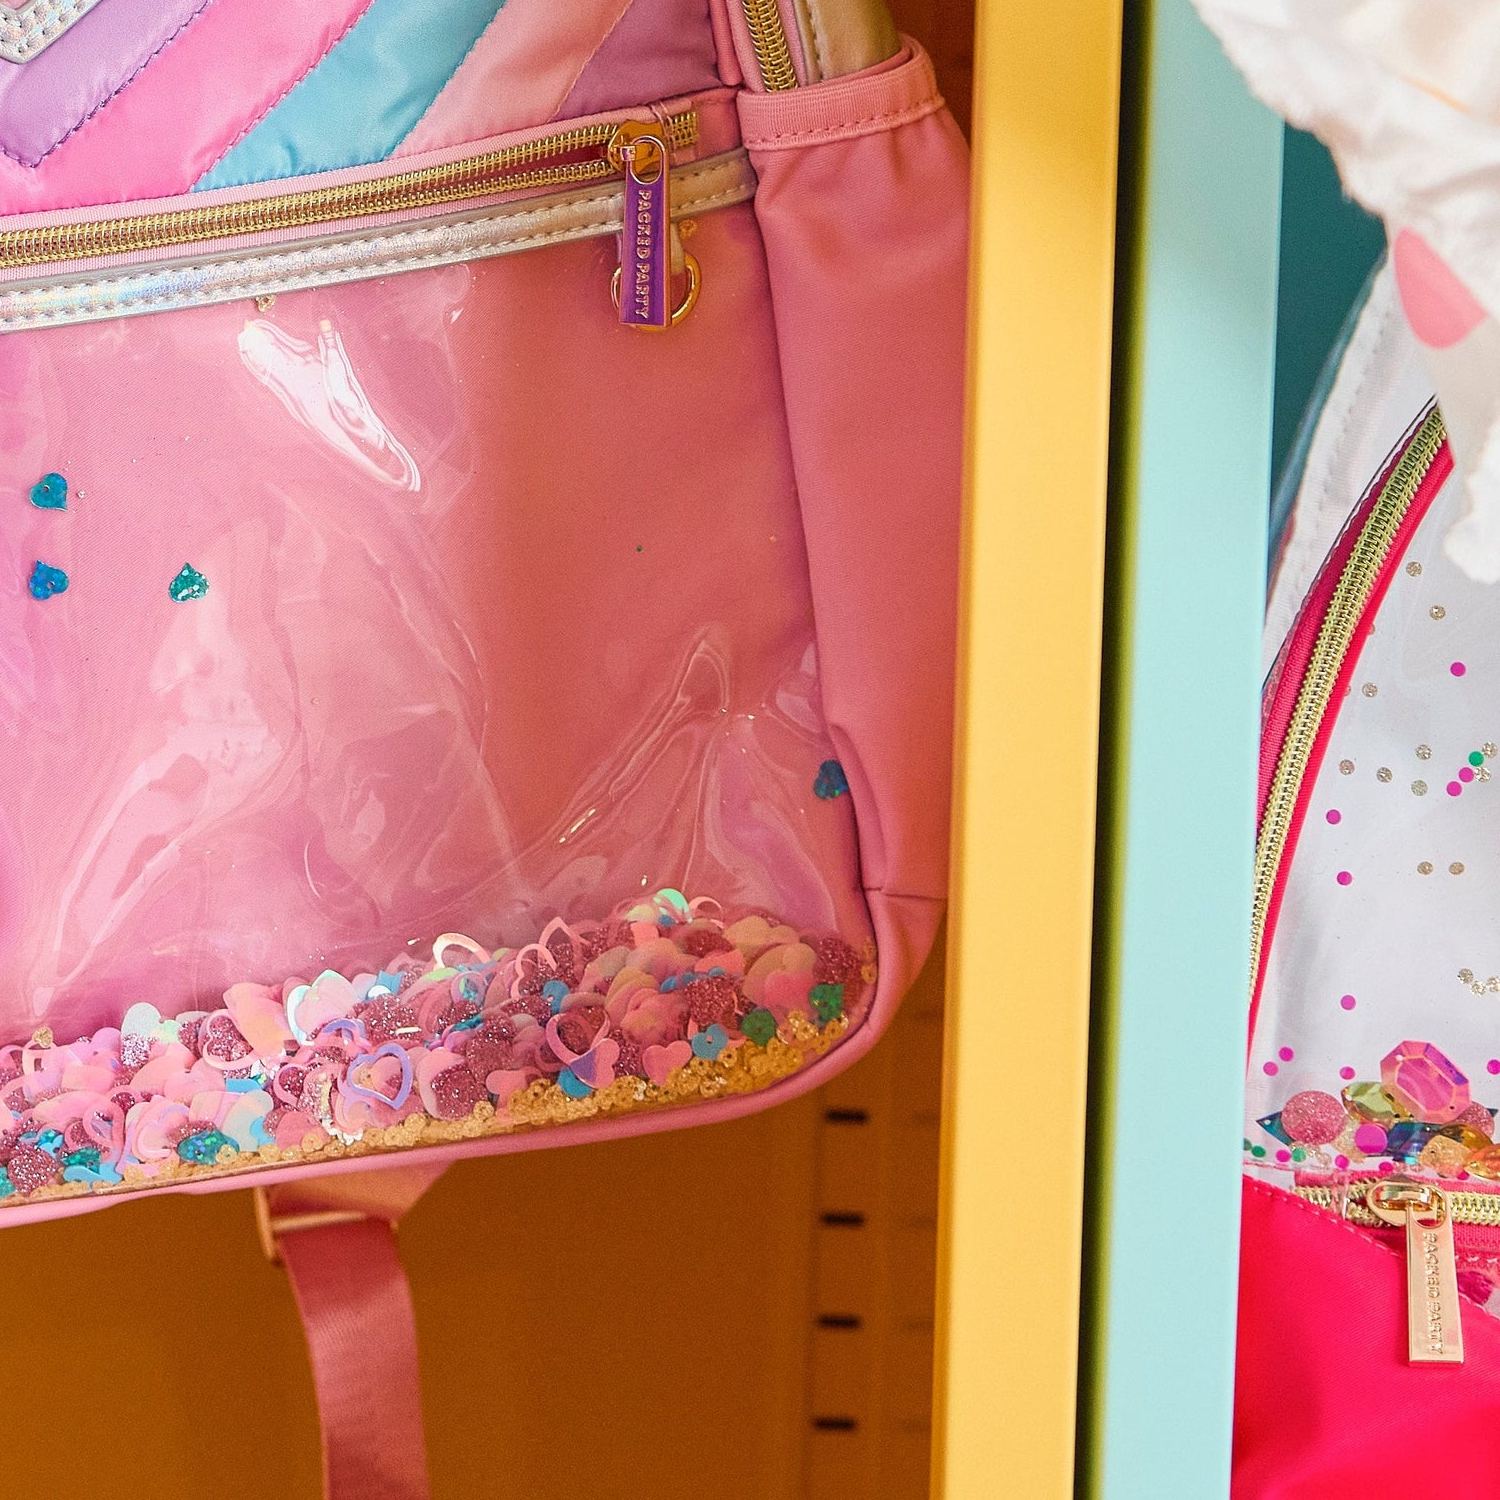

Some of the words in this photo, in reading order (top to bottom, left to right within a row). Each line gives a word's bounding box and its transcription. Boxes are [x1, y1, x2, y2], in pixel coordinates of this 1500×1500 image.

[636, 189, 652, 259] PACKED
[635, 264, 651, 319] PARTY
[1422, 1232, 1440, 1299] PACKED
[1427, 1301, 1444, 1355] PARTY
